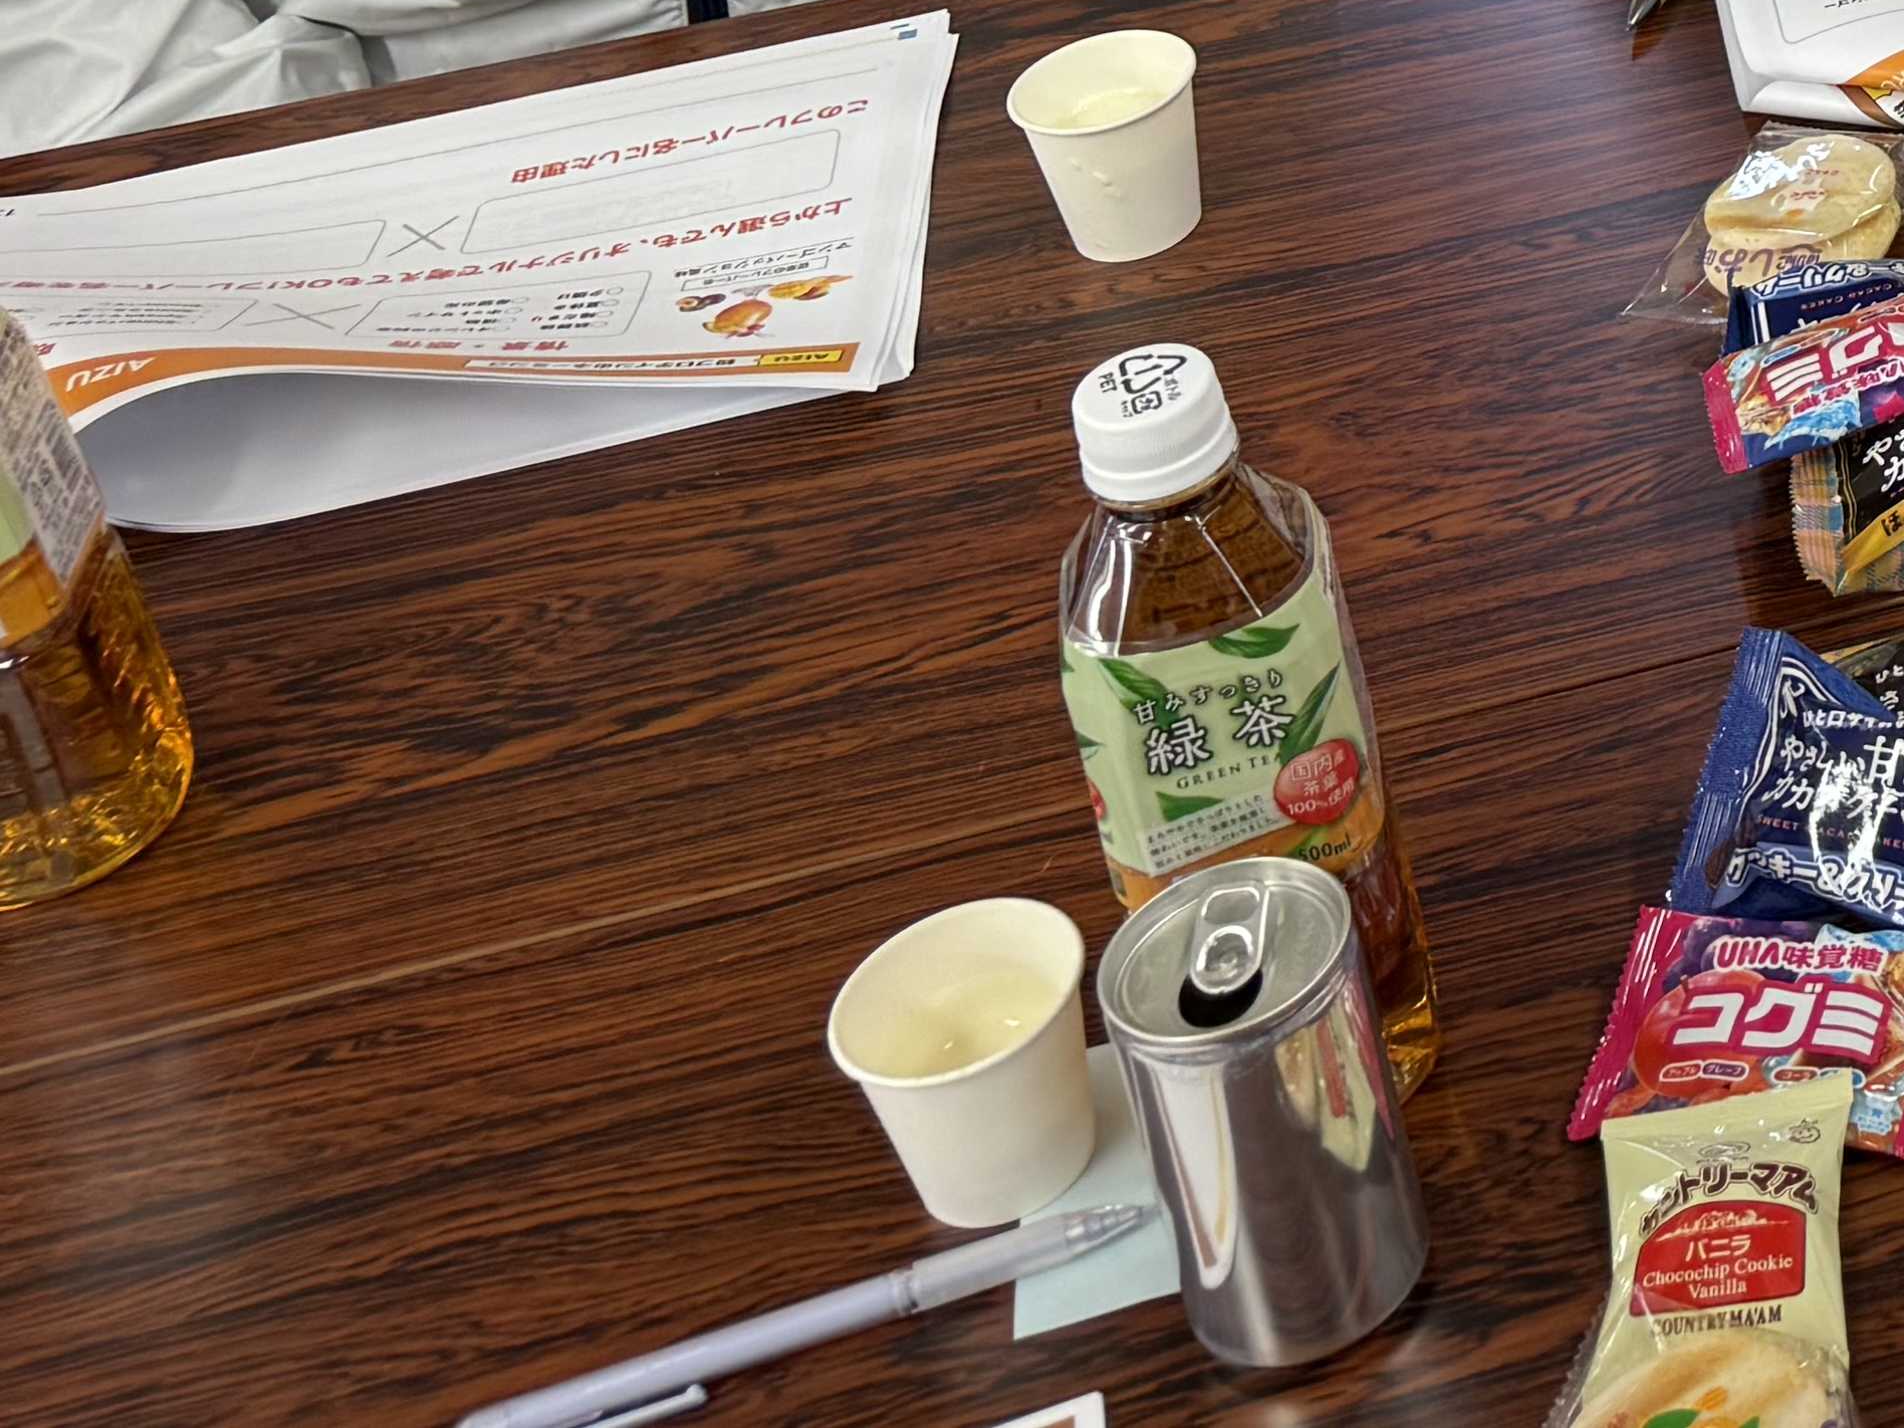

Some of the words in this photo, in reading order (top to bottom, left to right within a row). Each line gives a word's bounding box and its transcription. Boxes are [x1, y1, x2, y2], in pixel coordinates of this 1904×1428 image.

[511, 99, 868, 183] このフレーバー名にした理由
[65, 356, 157, 392] AIZU
[1134, 668, 1284, 724] 甘みすっきり
[1146, 695, 1295, 775] 緑茶
[1176, 763, 1241, 789] GREEN
[1715, 937, 1884, 972] UHA味覚糖
[1673, 983, 1884, 1057] コグミ
[1686, 1234, 1751, 1262] バニラ
[1643, 1263, 1730, 1287] Chocochip
[1734, 1255, 1793, 1275] Cookie
[1689, 1278, 1747, 1299] Vanilla
